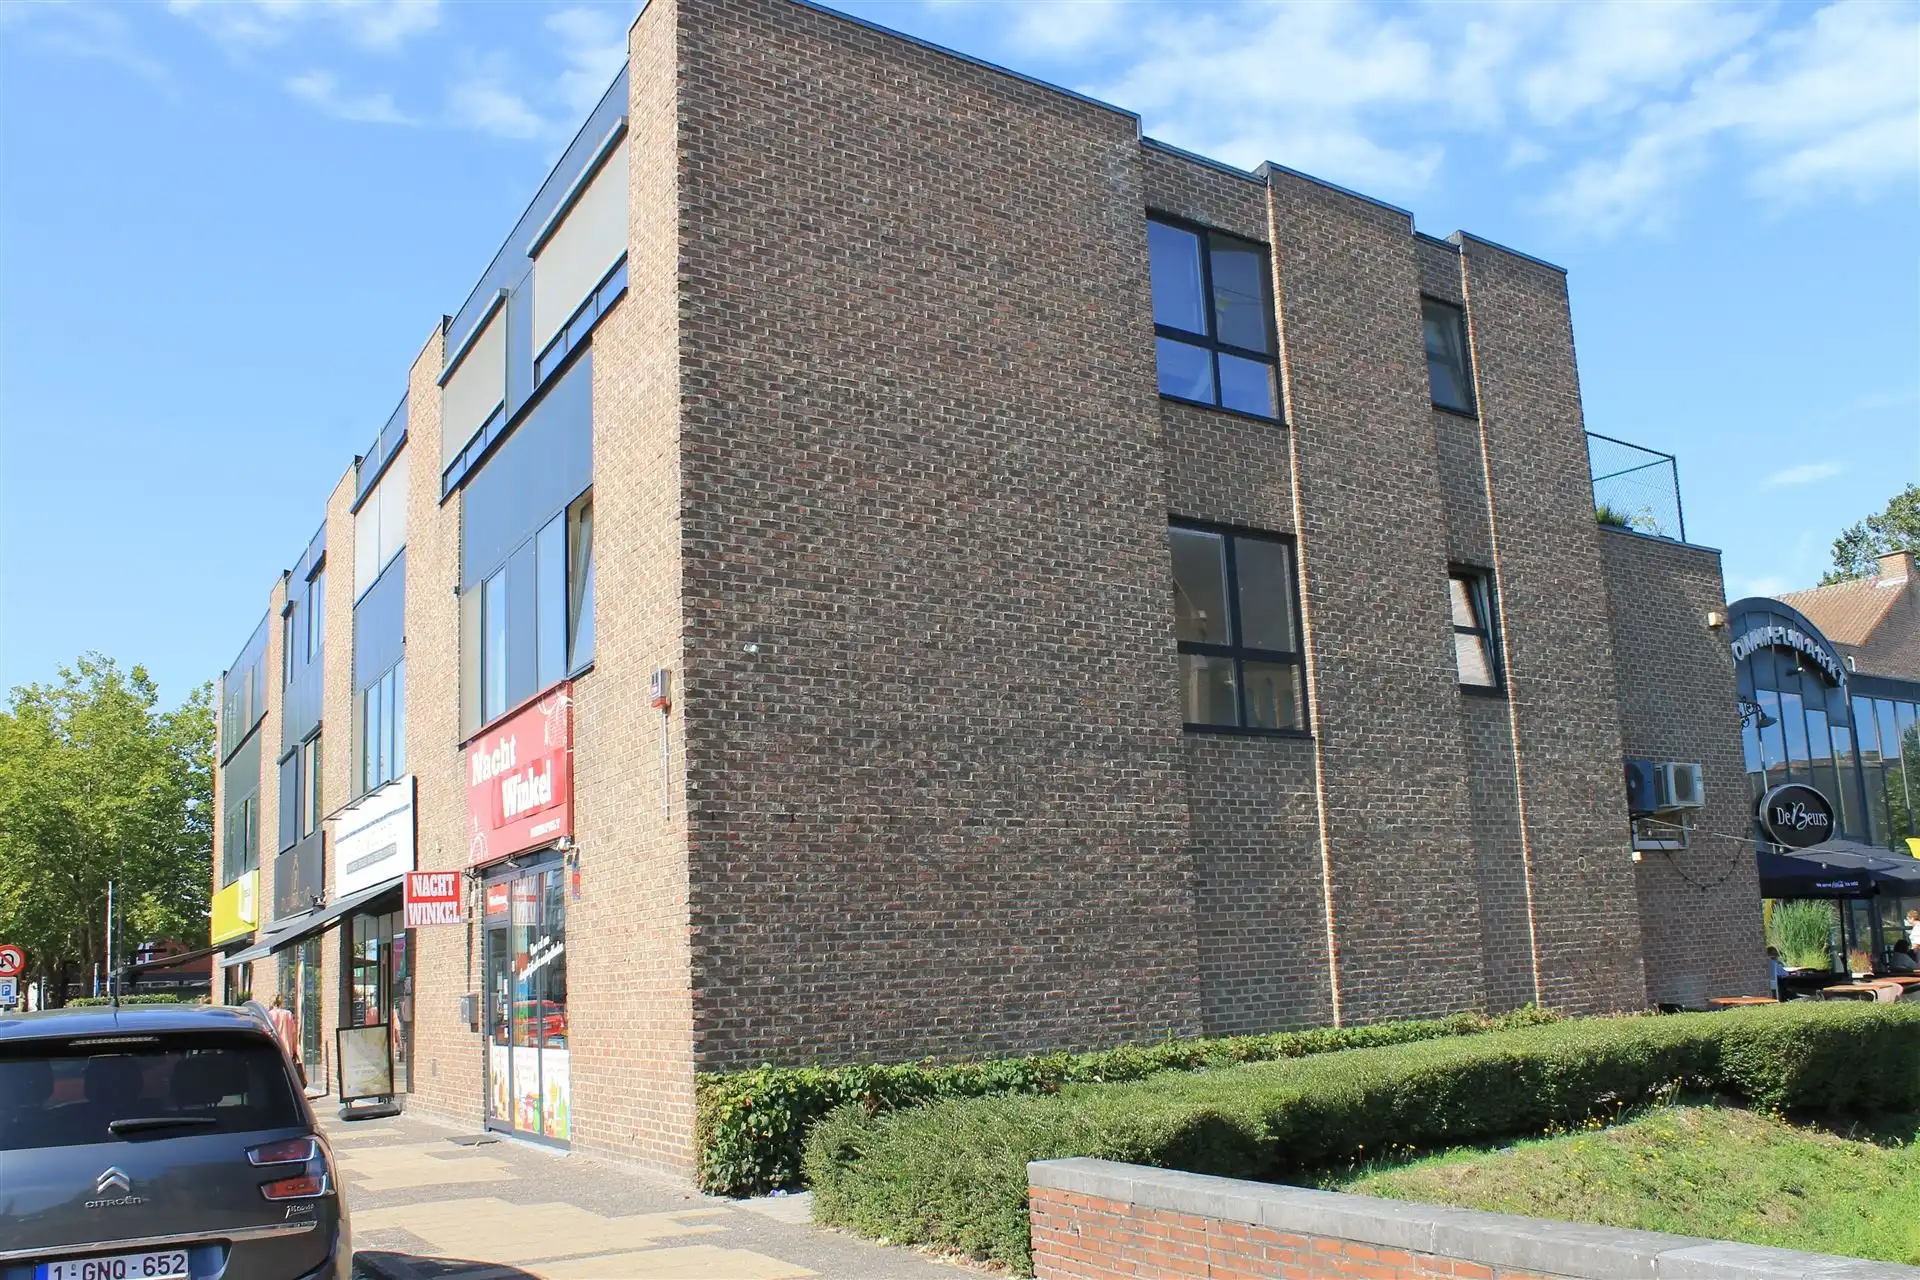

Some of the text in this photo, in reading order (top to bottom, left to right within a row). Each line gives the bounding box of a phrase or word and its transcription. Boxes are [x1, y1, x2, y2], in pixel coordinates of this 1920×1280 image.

[472, 733, 516, 788] Nacht
[502, 759, 552, 819] Winkel
[412, 874, 455, 897] NACHT
[408, 901, 460, 925] WINKEL
